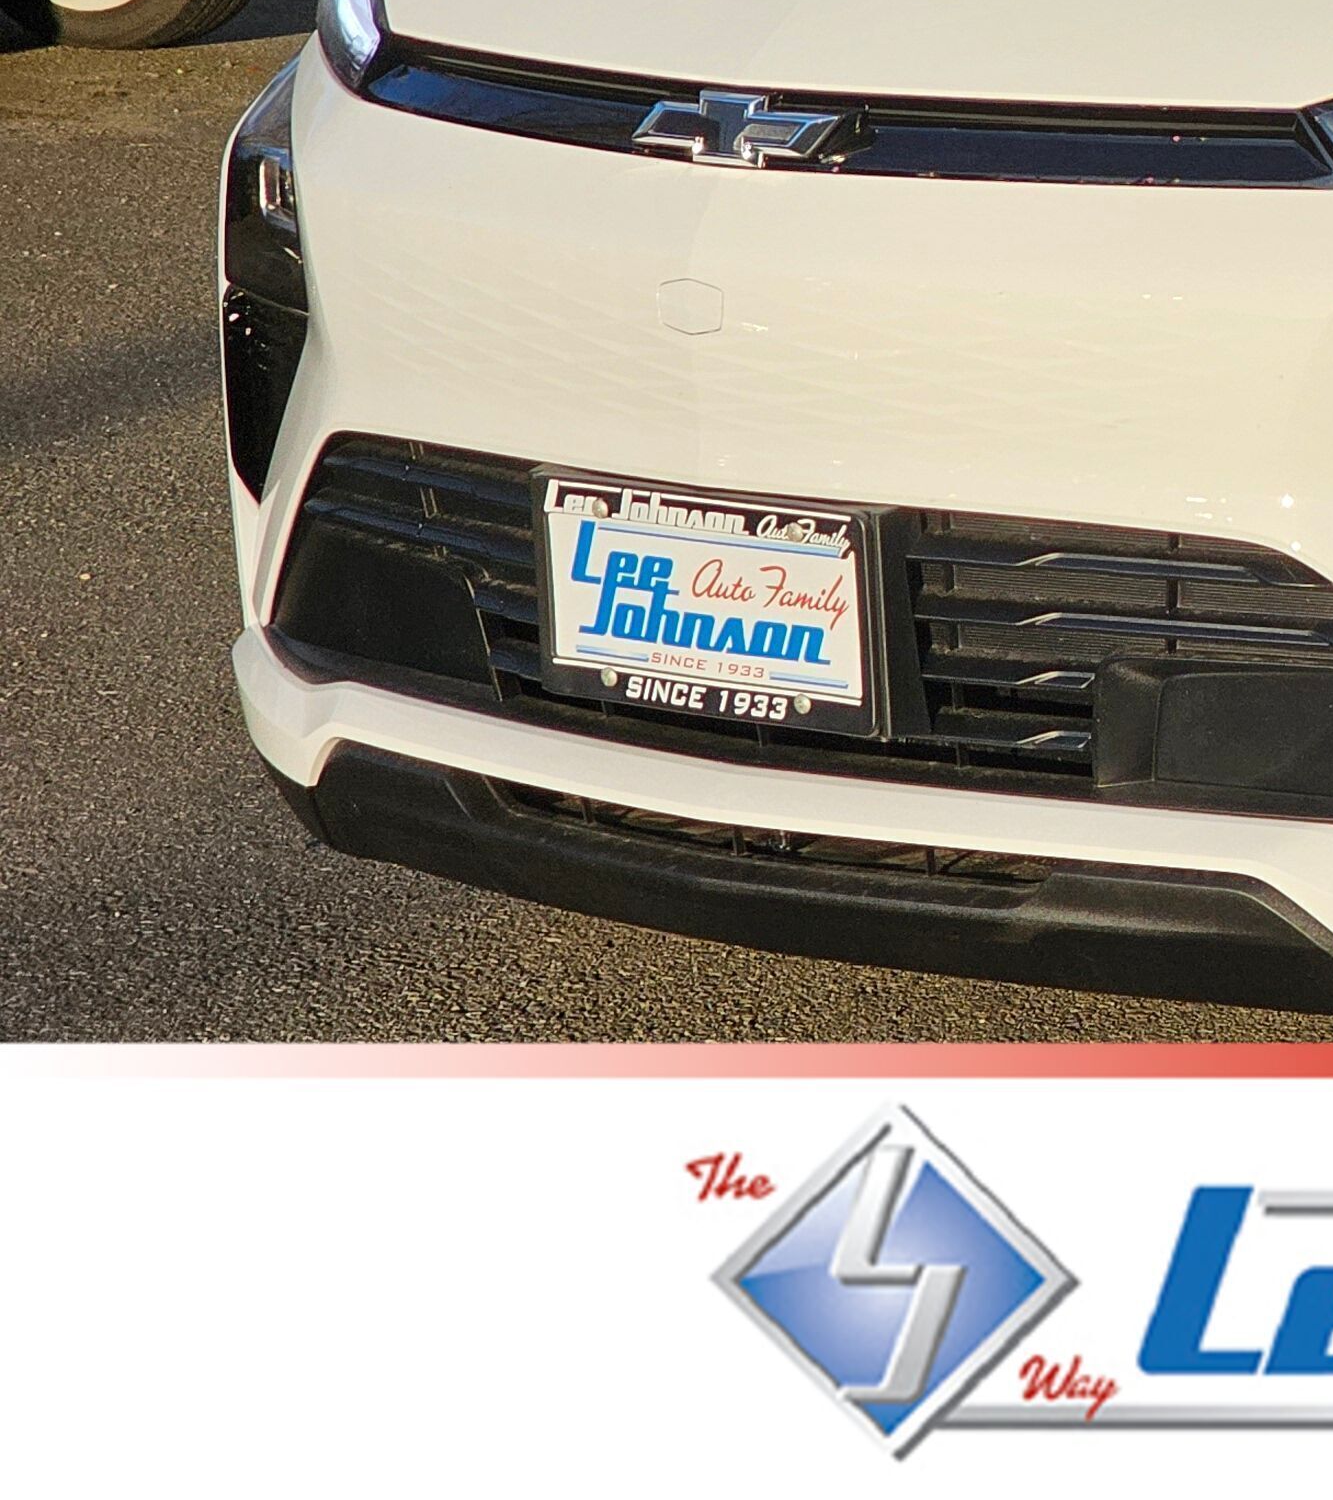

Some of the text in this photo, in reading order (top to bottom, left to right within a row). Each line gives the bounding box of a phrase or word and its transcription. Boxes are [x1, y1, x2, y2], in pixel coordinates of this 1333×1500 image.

[570, 520, 680, 596] Lee
[612, 488, 749, 536] Johnson
[797, 518, 850, 558] Family
[578, 577, 832, 665] Johnson
[692, 559, 850, 630] Auto Family
[626, 676, 788, 720] SINCE 1933
[651, 652, 765, 678] SINCE 1933
